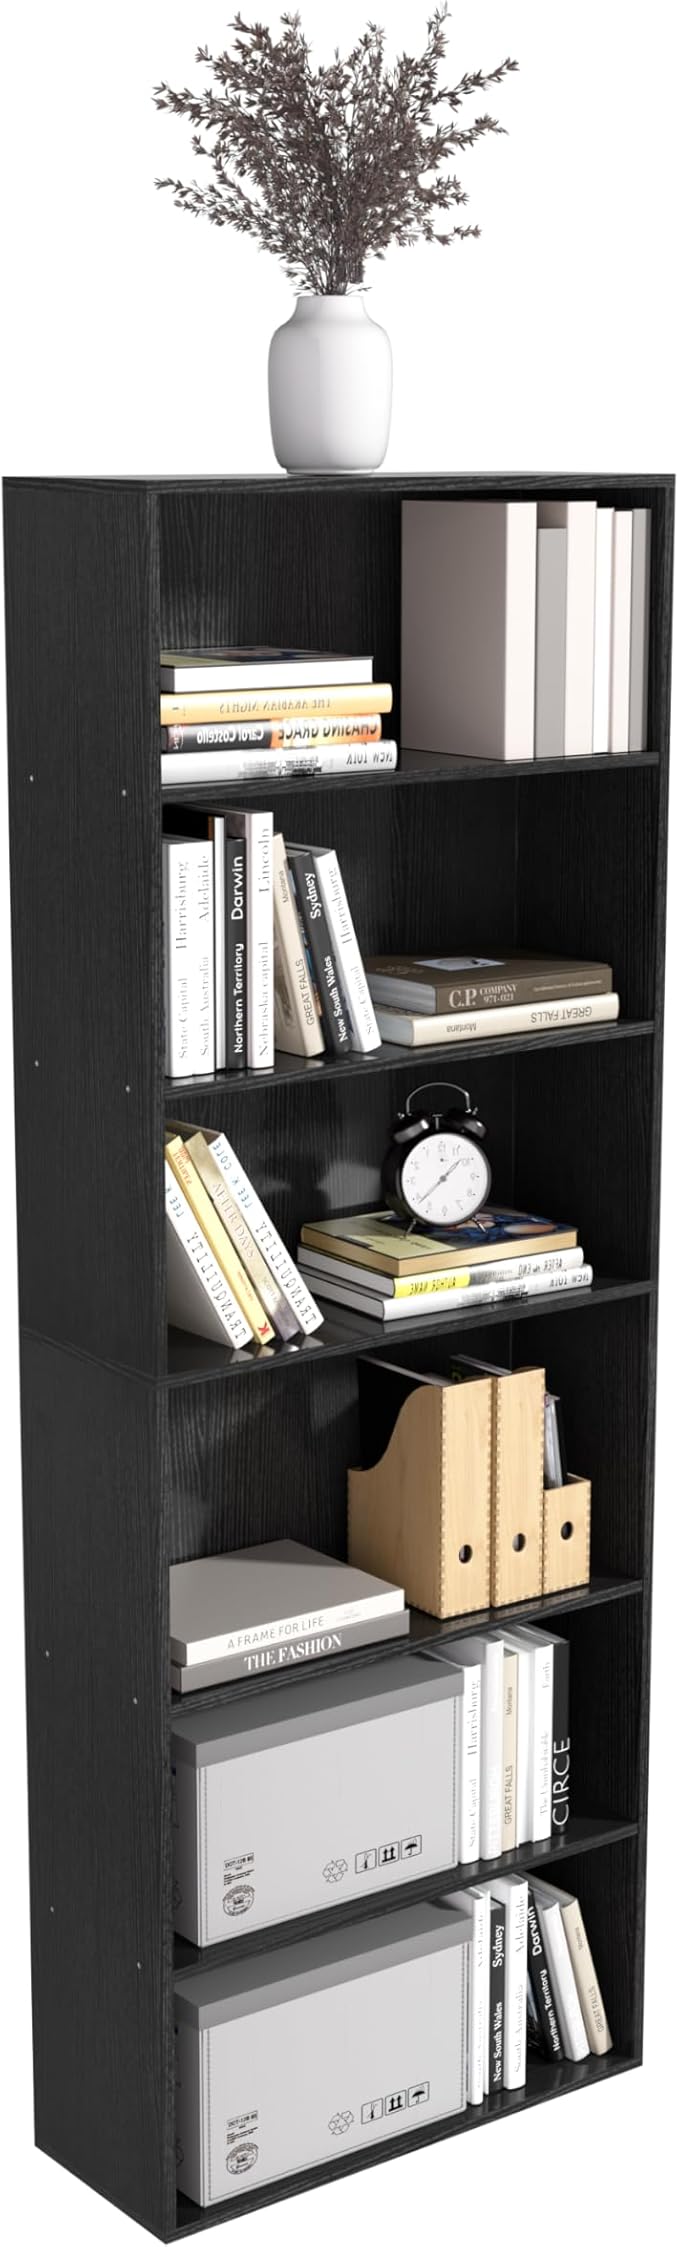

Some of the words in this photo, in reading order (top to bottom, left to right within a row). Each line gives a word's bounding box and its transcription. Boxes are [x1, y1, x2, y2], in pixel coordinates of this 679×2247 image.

[259, 828, 270, 893] Lincoln
[198, 855, 209, 922] Adelaide
[231, 855, 244, 921] Darwin
[279, 870, 289, 903] Montana
[304, 872, 322, 919] Sydney
[175, 861, 189, 950] Harrisburg
[329, 867, 352, 945] Harrisburg
[233, 943, 245, 995] Territory
[259, 942, 271, 990] capital
[296, 959, 310, 991] FALLS
[324, 955, 339, 986] Wales
[301, 989, 314, 1025] GREAT
[331, 986, 344, 1018] South
[449, 988, 477, 1008] C.P.
[479, 983, 518, 995] COMPANY
[233, 997, 244, 1054] Northern
[259, 993, 271, 1057] Nebraska
[338, 1020, 348, 1042] New
[446, 1022, 477, 1033] Montana
[531, 1009, 559, 1023] FALLS
[559, 1006, 593, 1020] GREAT
[198, 1020, 209, 1056] South
[227, 1638, 236, 1649] A
[237, 1630, 275, 1648] FRAME
[278, 1622, 299, 1637] FOR
[301, 1616, 325, 1632] LIFE
[244, 1649, 276, 1671] THE
[278, 1632, 343, 1665] FASHION
[467, 1679, 480, 1755] Harrisburg
[504, 1765, 513, 1793] FALLS
[552, 1737, 570, 1826] CIRCE
[504, 1794, 513, 1825] GREAT
[492, 1925, 505, 1968] Sydney
[528, 1906, 542, 1956] Darwin
[539, 1970, 554, 2011] Territory
[493, 2002, 503, 2029] Wales
[548, 2010, 561, 2052] Northern
[493, 2031, 503, 2060] South
[493, 2062, 503, 2083] New
